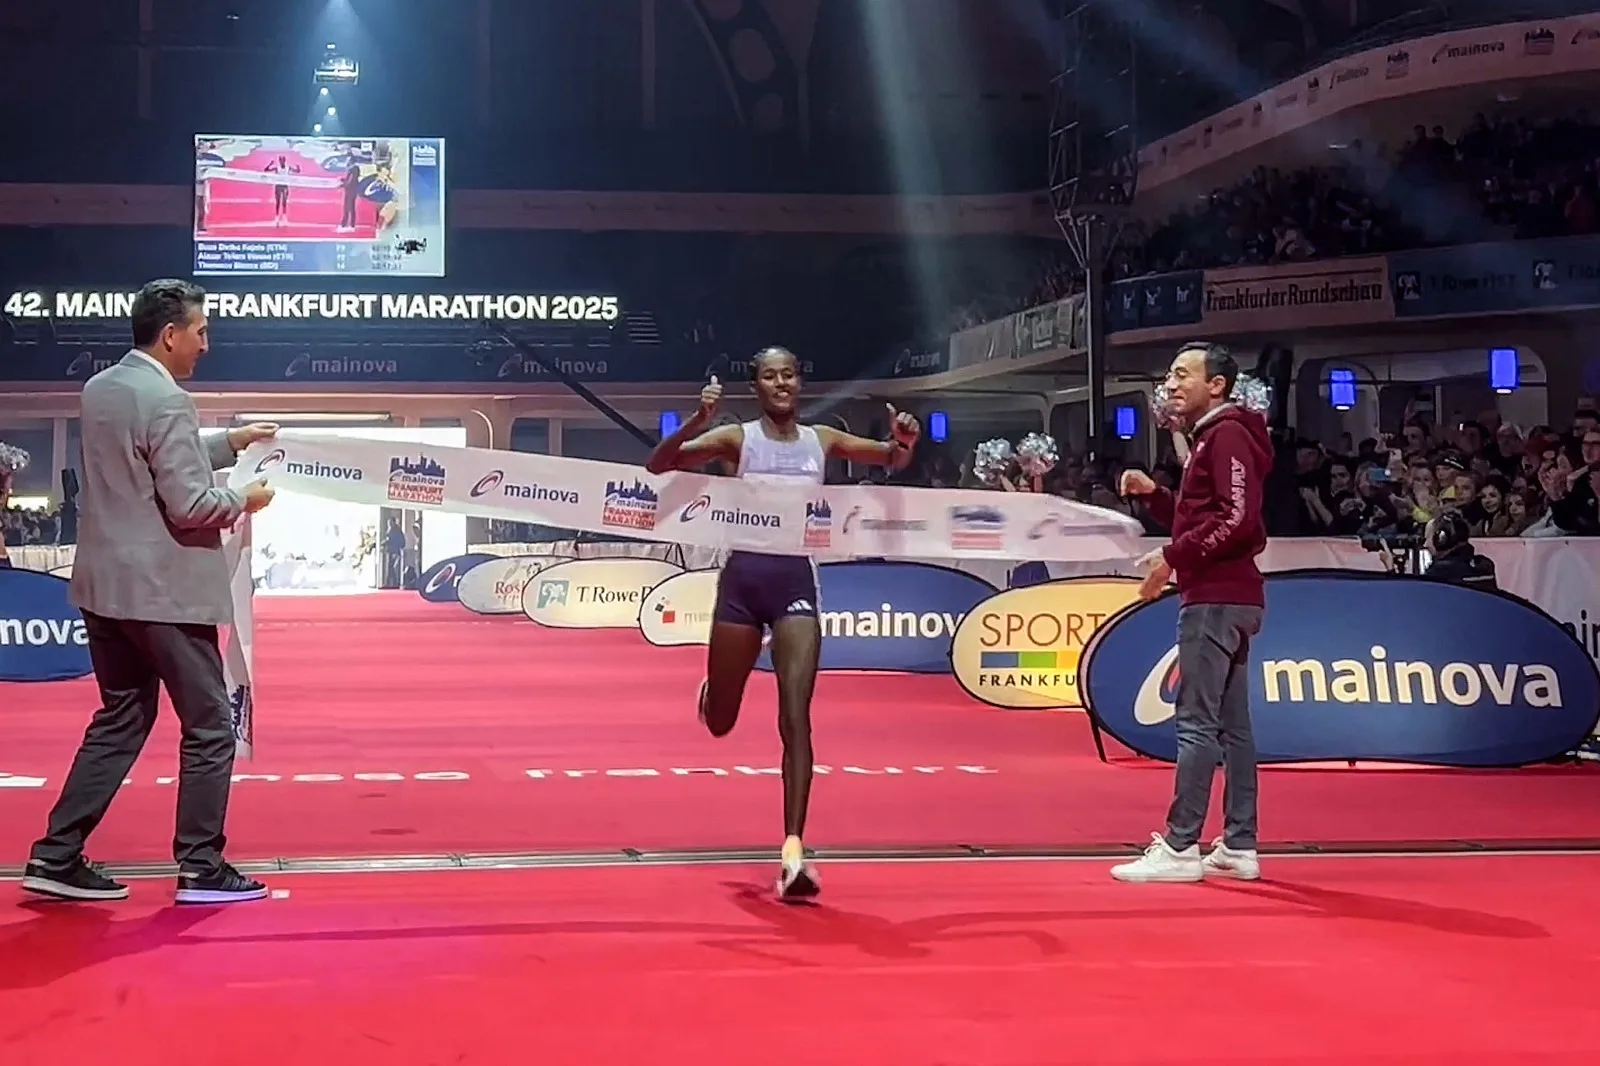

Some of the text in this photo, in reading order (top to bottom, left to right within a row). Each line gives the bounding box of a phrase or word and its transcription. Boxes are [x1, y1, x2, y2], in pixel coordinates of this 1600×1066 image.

[4, 293, 50, 318] 42.
[203, 293, 378, 318] FRANKFURT
[381, 294, 548, 320] MARATHON
[551, 295, 618, 320] 2025
[311, 355, 397, 374] mainova
[523, 356, 608, 374] minova
[286, 461, 363, 481] mainova
[402, 473, 445, 486] mainova
[503, 484, 580, 505] mainova
[710, 505, 781, 529] mainova
[1262, 645, 1564, 708] mainova
